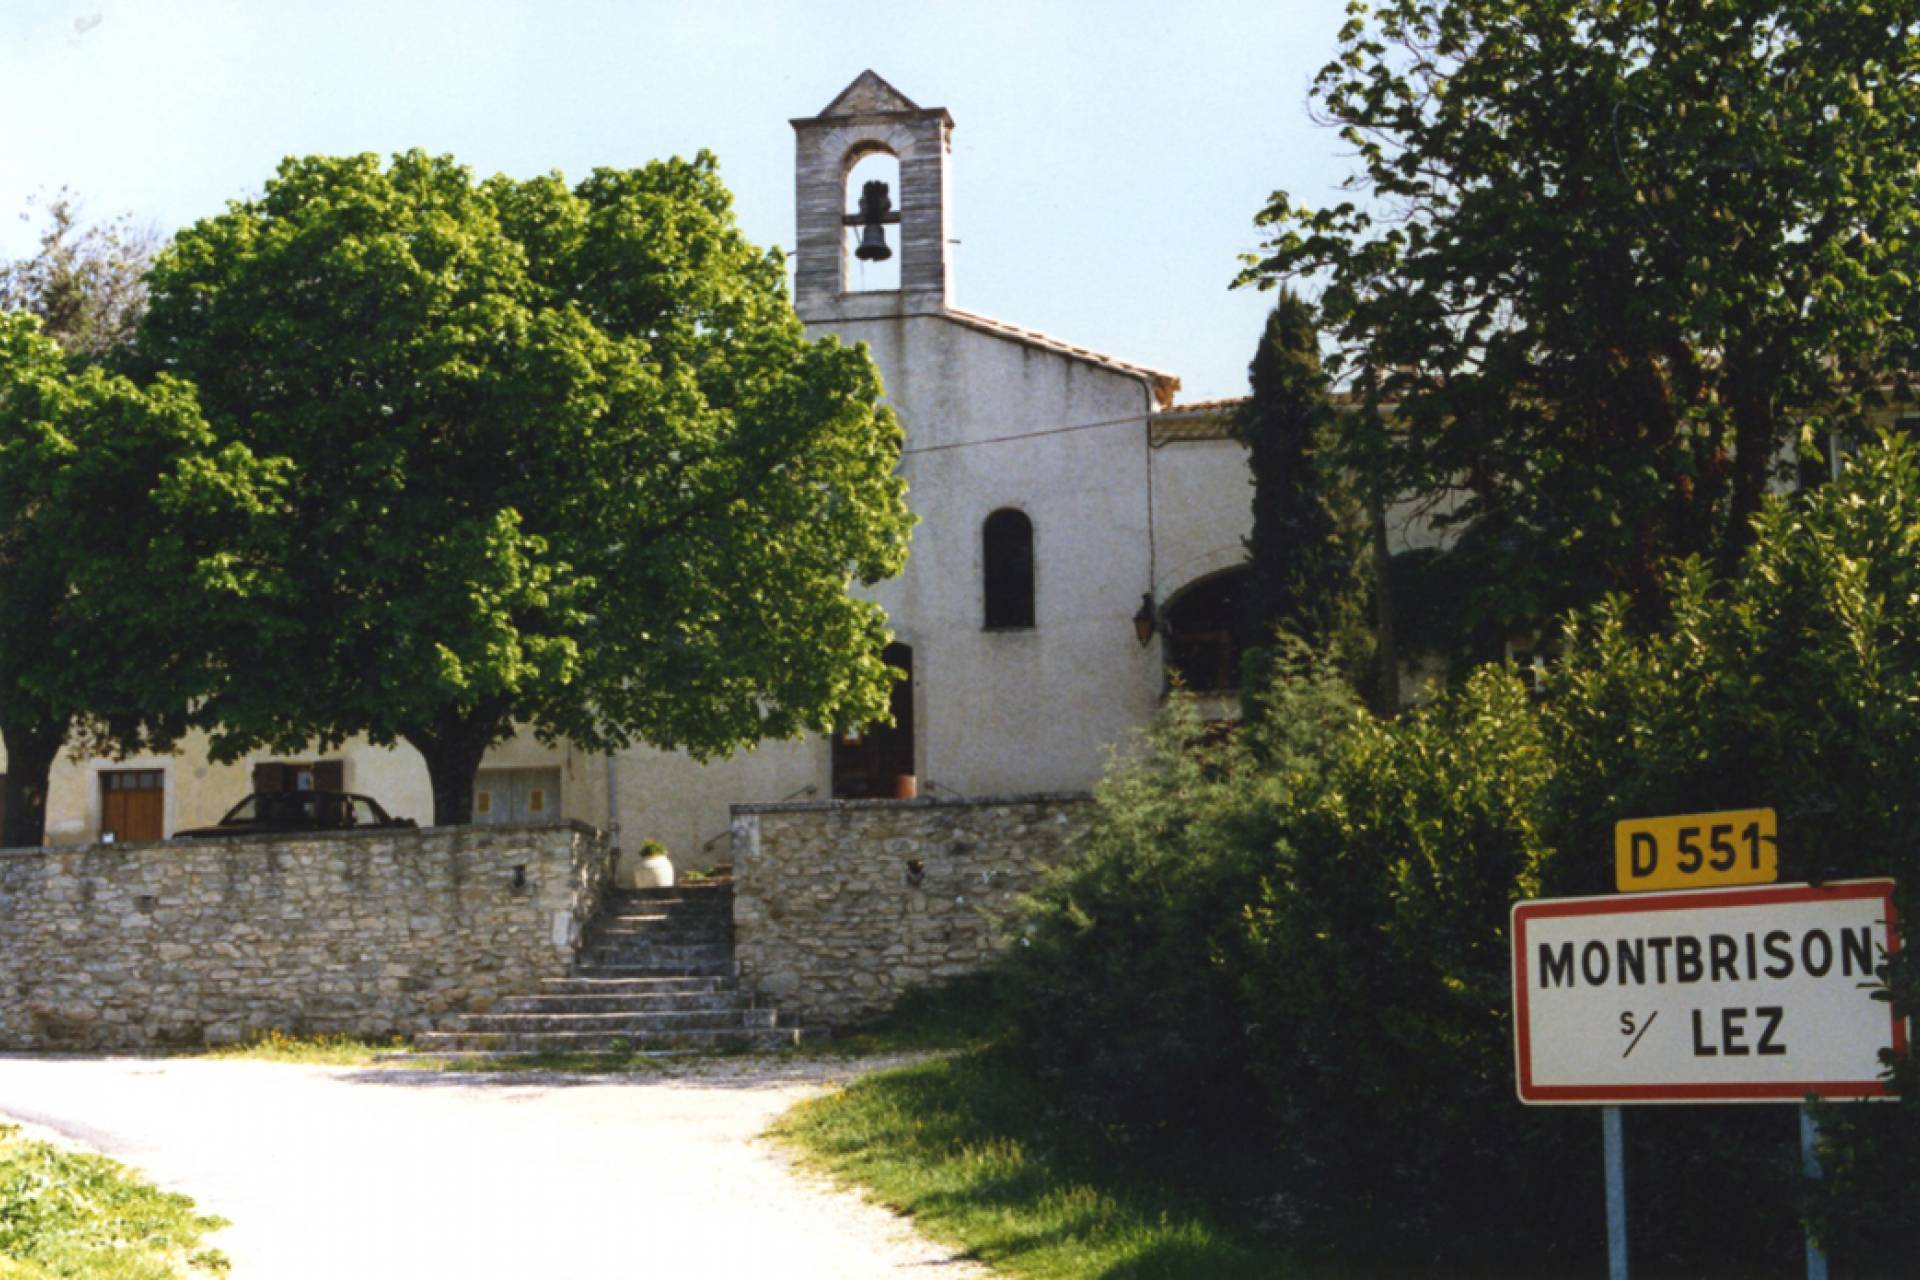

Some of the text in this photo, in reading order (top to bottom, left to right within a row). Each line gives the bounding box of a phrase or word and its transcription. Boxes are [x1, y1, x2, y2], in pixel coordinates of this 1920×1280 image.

[1631, 822, 1760, 878] D 551
[1539, 927, 1873, 989] MONTBRISON
[1692, 1006, 1786, 1057] LEZ
